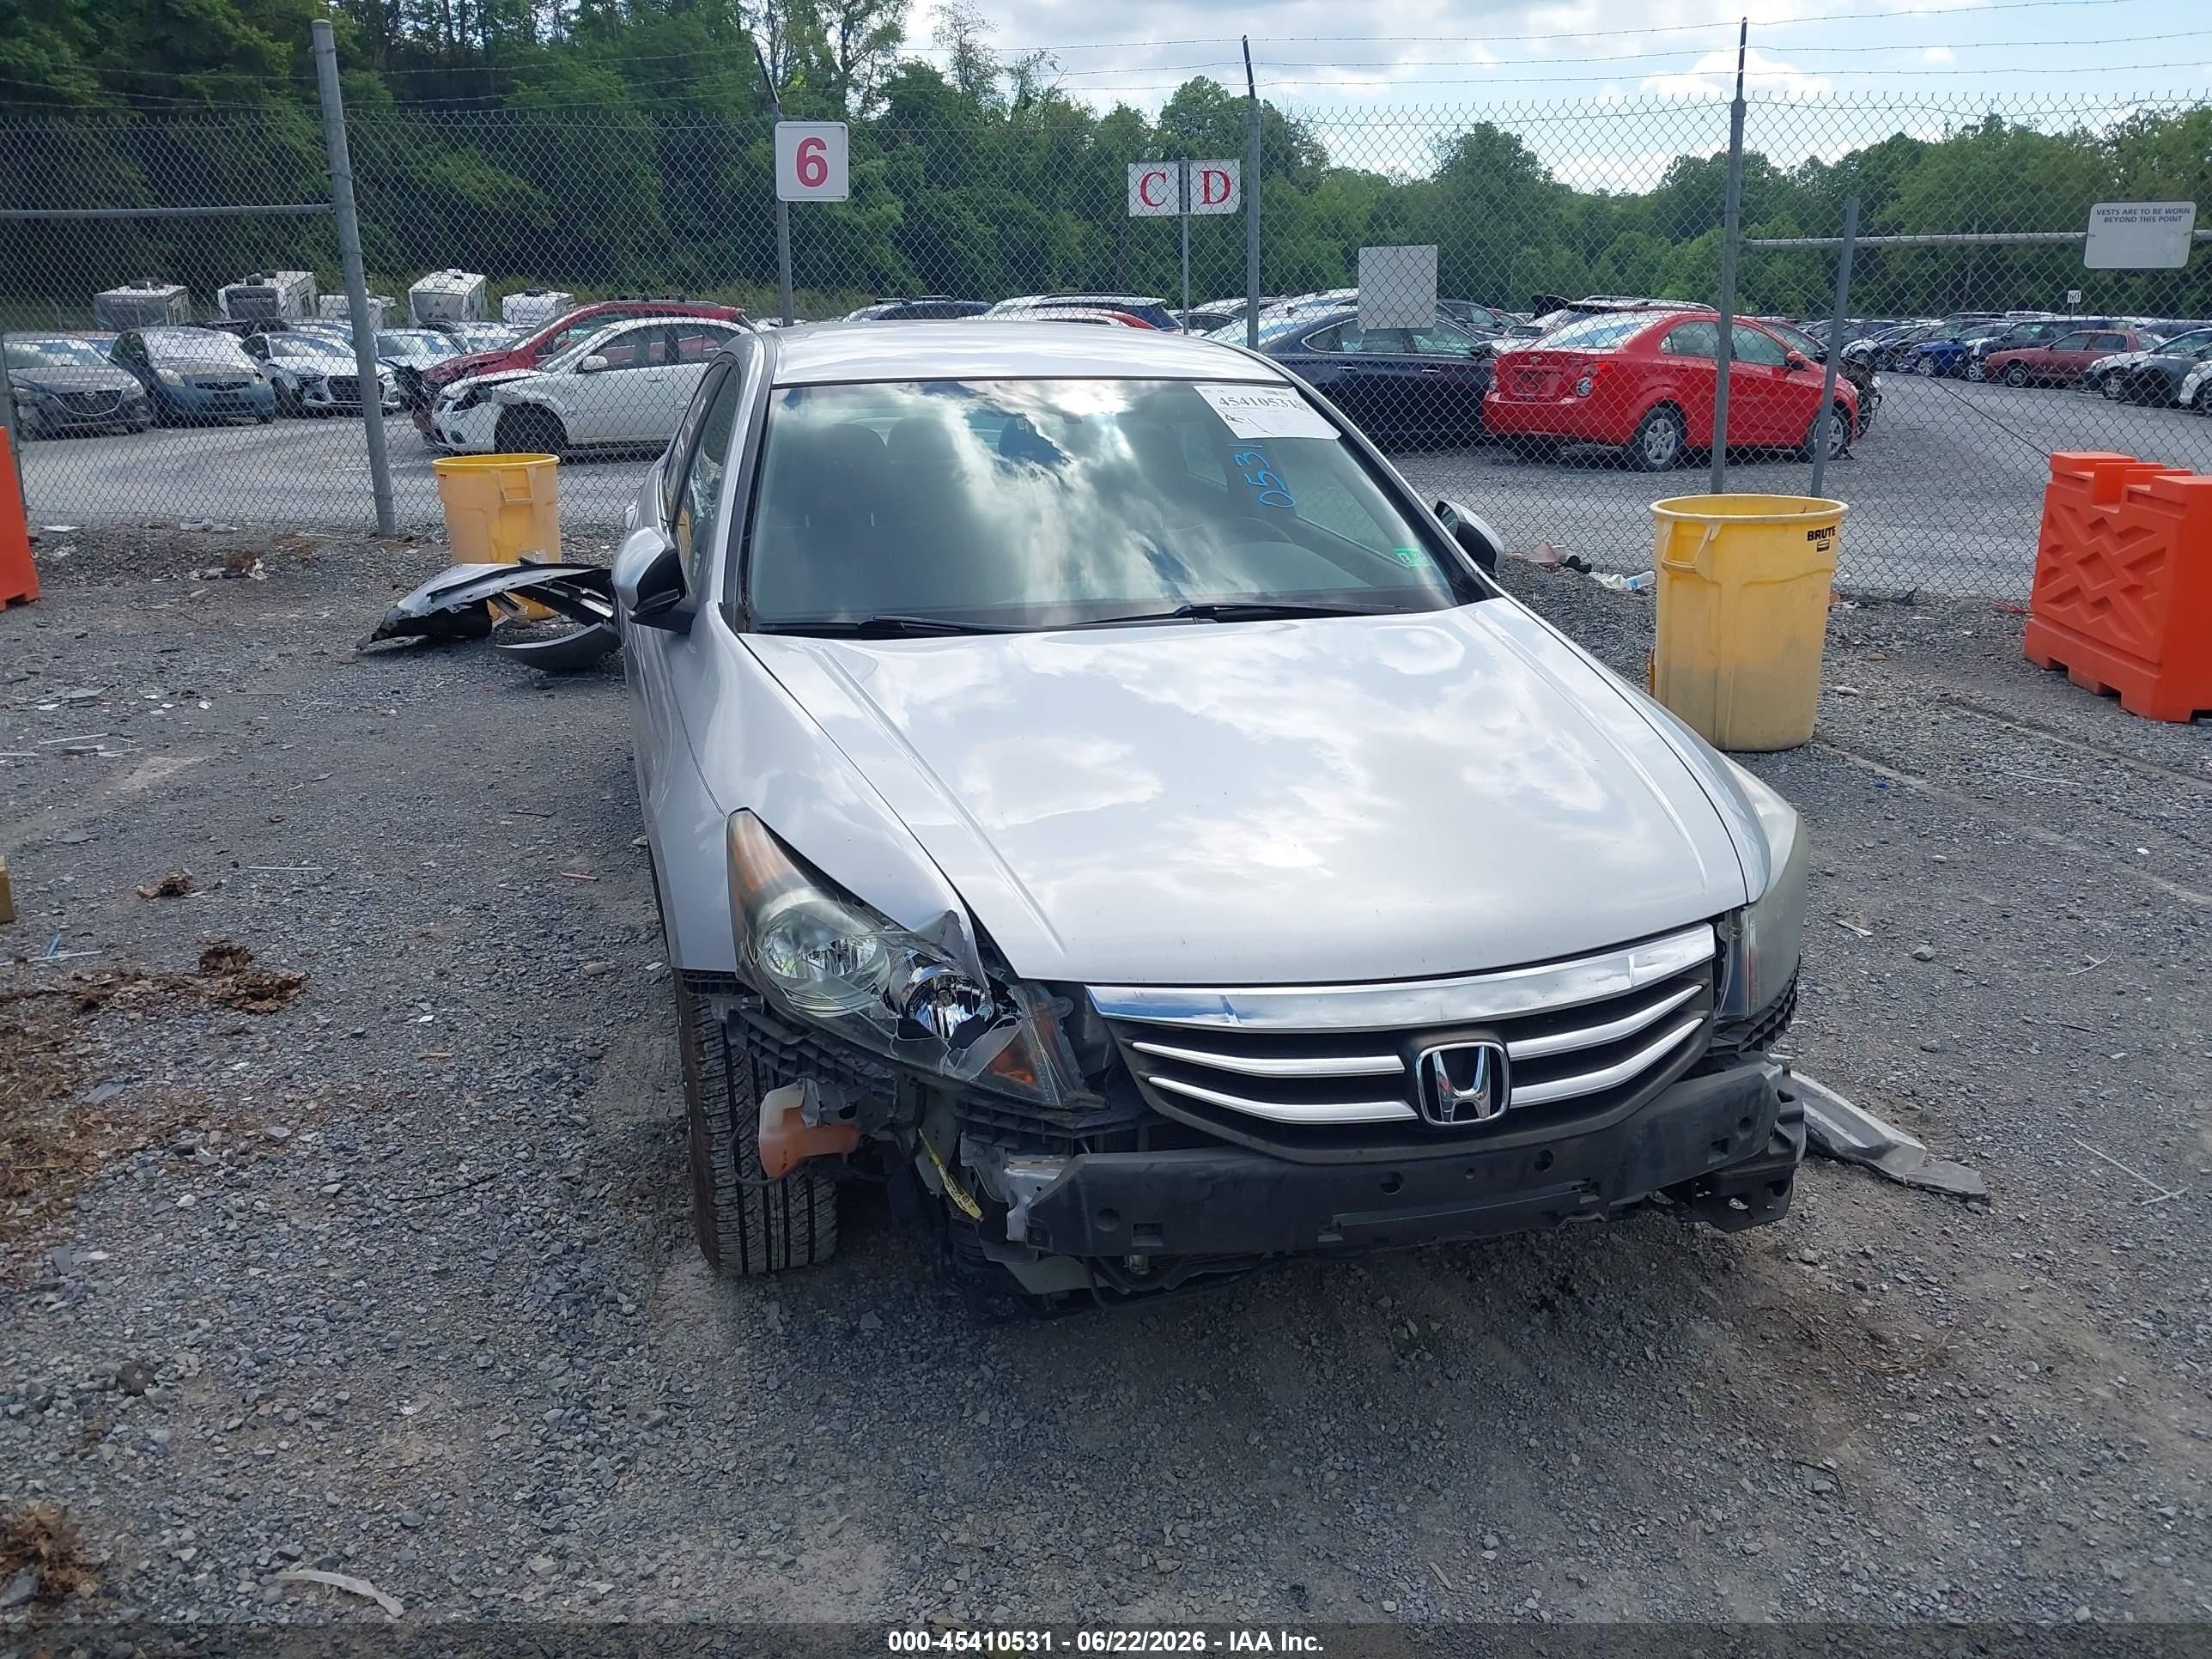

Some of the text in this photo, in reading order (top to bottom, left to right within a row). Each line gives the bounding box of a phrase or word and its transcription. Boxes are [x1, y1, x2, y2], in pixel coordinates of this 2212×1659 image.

[796, 137, 829, 188] 6
[1139, 171, 1168, 207] C
[1200, 170, 1231, 204] D
[1219, 397, 1297, 409] 45410531
[1228, 444, 1297, 508] 0531
[1807, 526, 1836, 542] BRUTE
